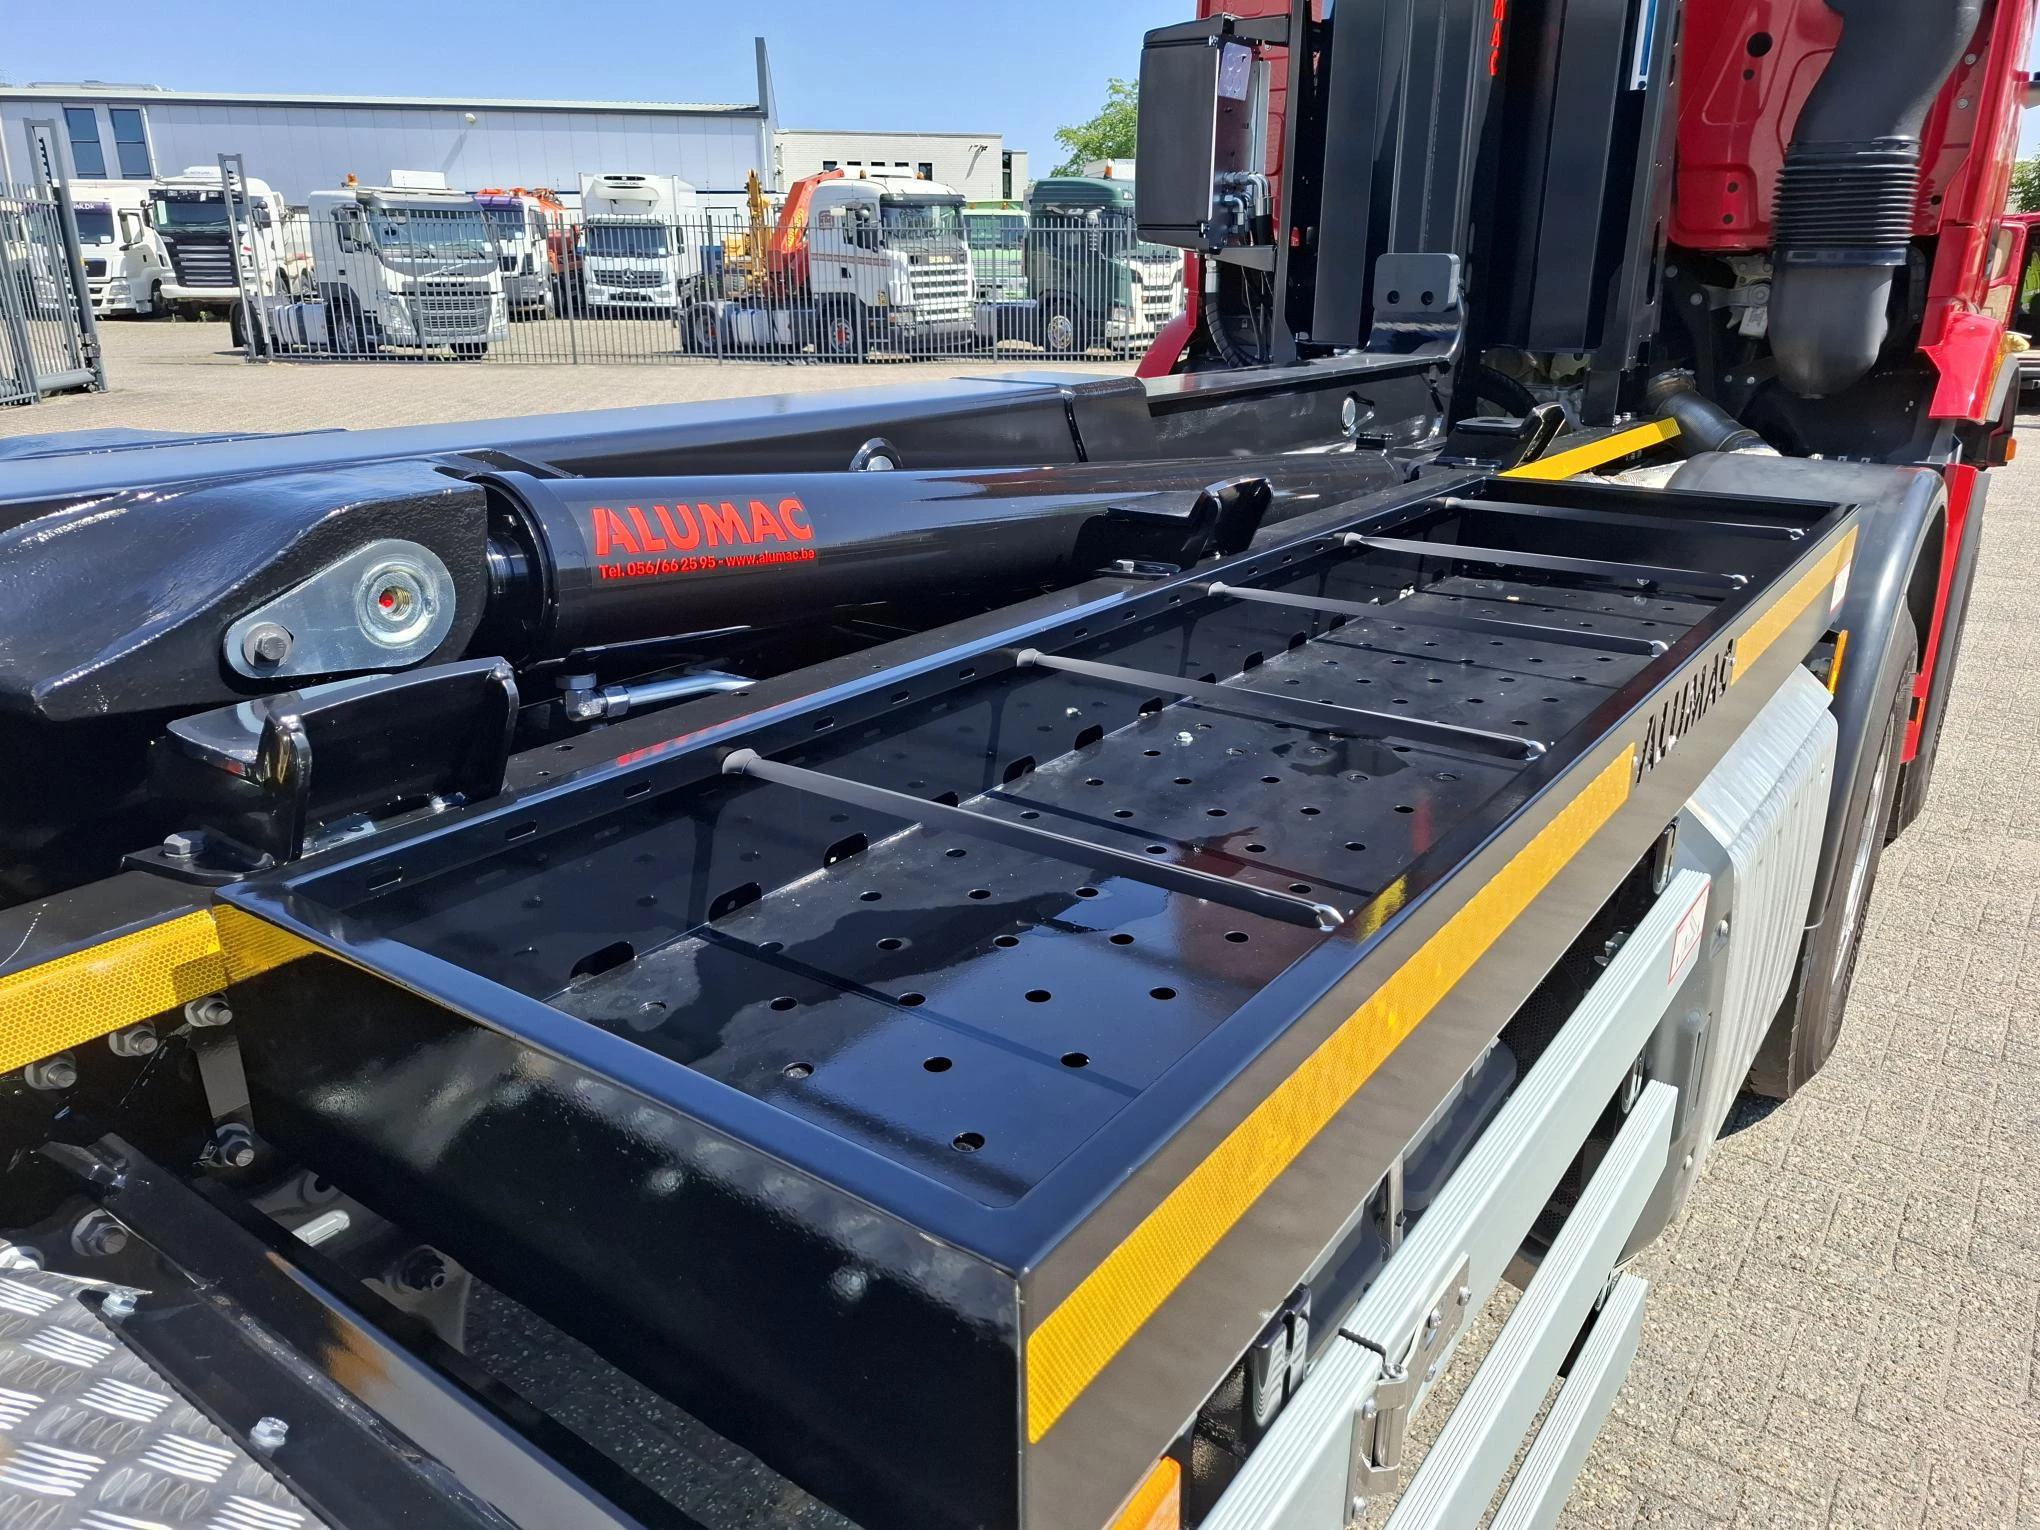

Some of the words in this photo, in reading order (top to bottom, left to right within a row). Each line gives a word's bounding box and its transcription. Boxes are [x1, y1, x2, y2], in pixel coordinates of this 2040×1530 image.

[591, 498, 813, 556] ALUMAC
[599, 564, 624, 579] Tel.
[627, 556, 678, 576] 056/66
[680, 556, 697, 572] 25
[699, 555, 716, 570] 95
[726, 548, 815, 567] www.alumac.be
[1636, 638, 1735, 782] ALUMAC
